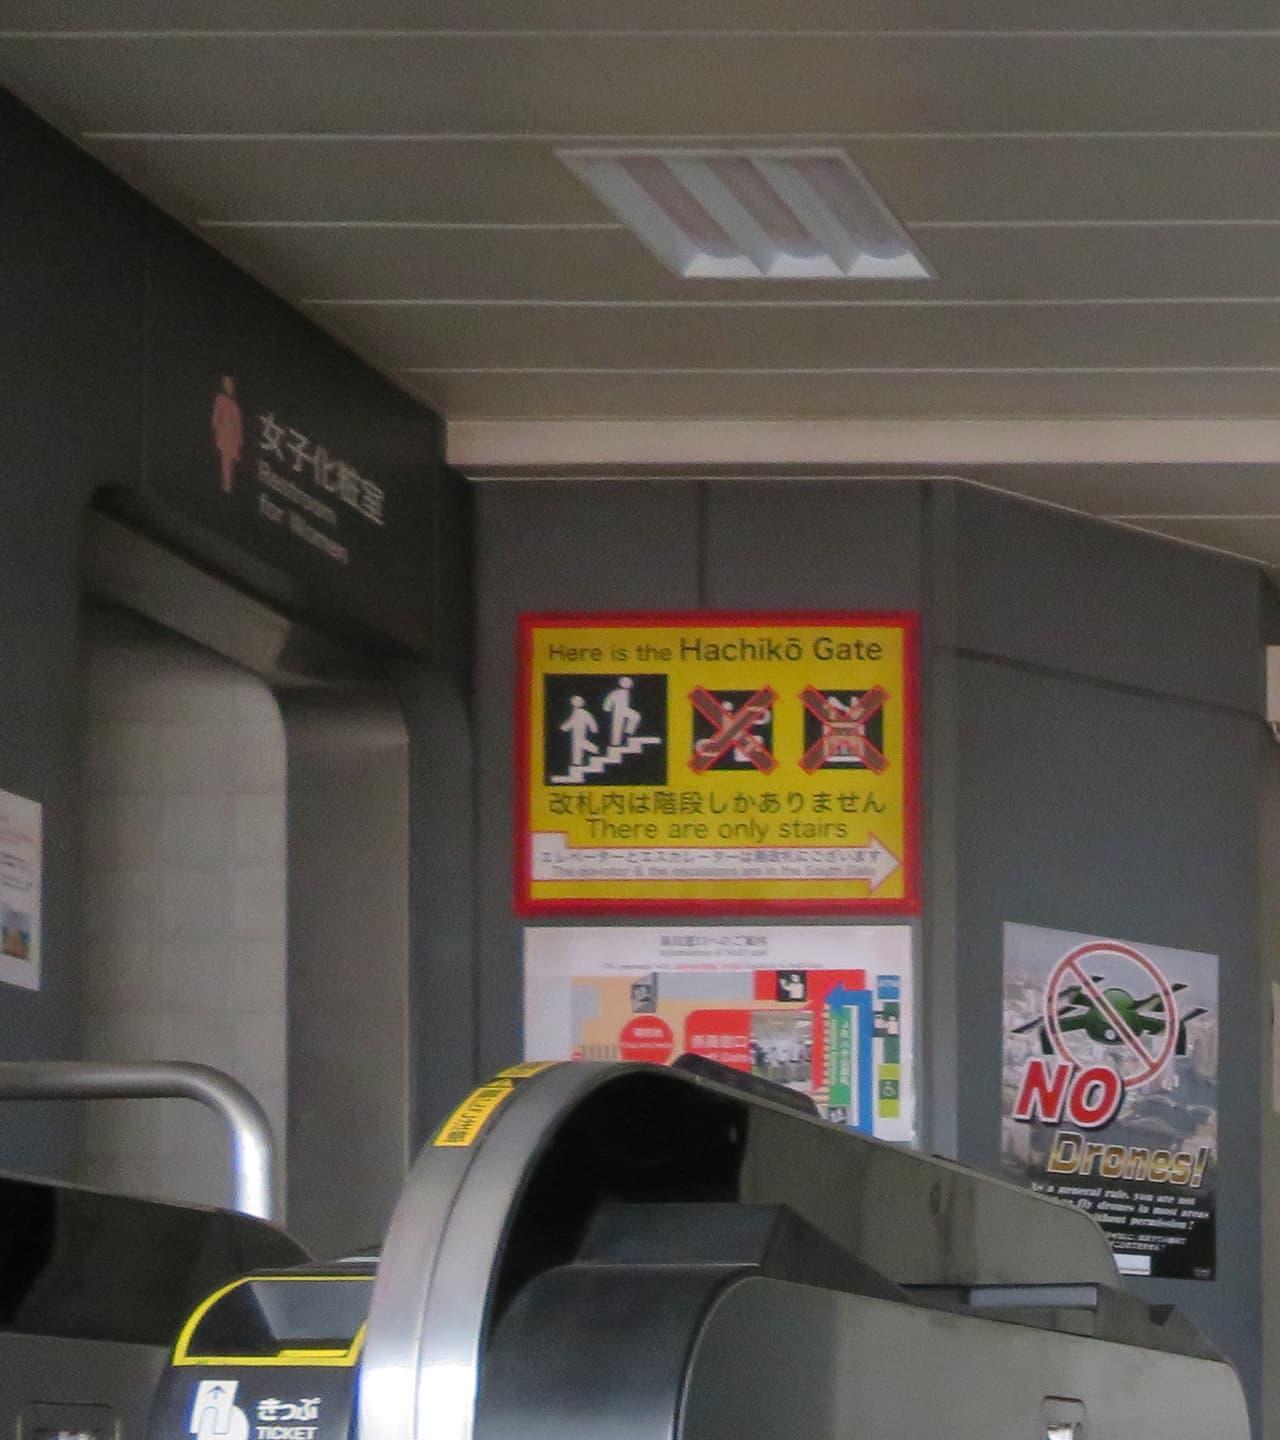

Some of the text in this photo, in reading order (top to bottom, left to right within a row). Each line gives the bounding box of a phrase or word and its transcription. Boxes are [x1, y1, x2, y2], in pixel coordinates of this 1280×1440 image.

[548, 644, 603, 663] Here
[610, 643, 628, 663] is
[635, 643, 672, 663] the
[813, 636, 884, 662] Gate
[548, 791, 886, 817] 改札内は階段しかありません
[586, 818, 850, 844] There are only stairs
[1011, 1059, 1124, 1129] NO
[1046, 1130, 1209, 1188] Drones!
[255, 1397, 322, 1422] きっぷ
[255, 1425, 319, 1440] TICKET
